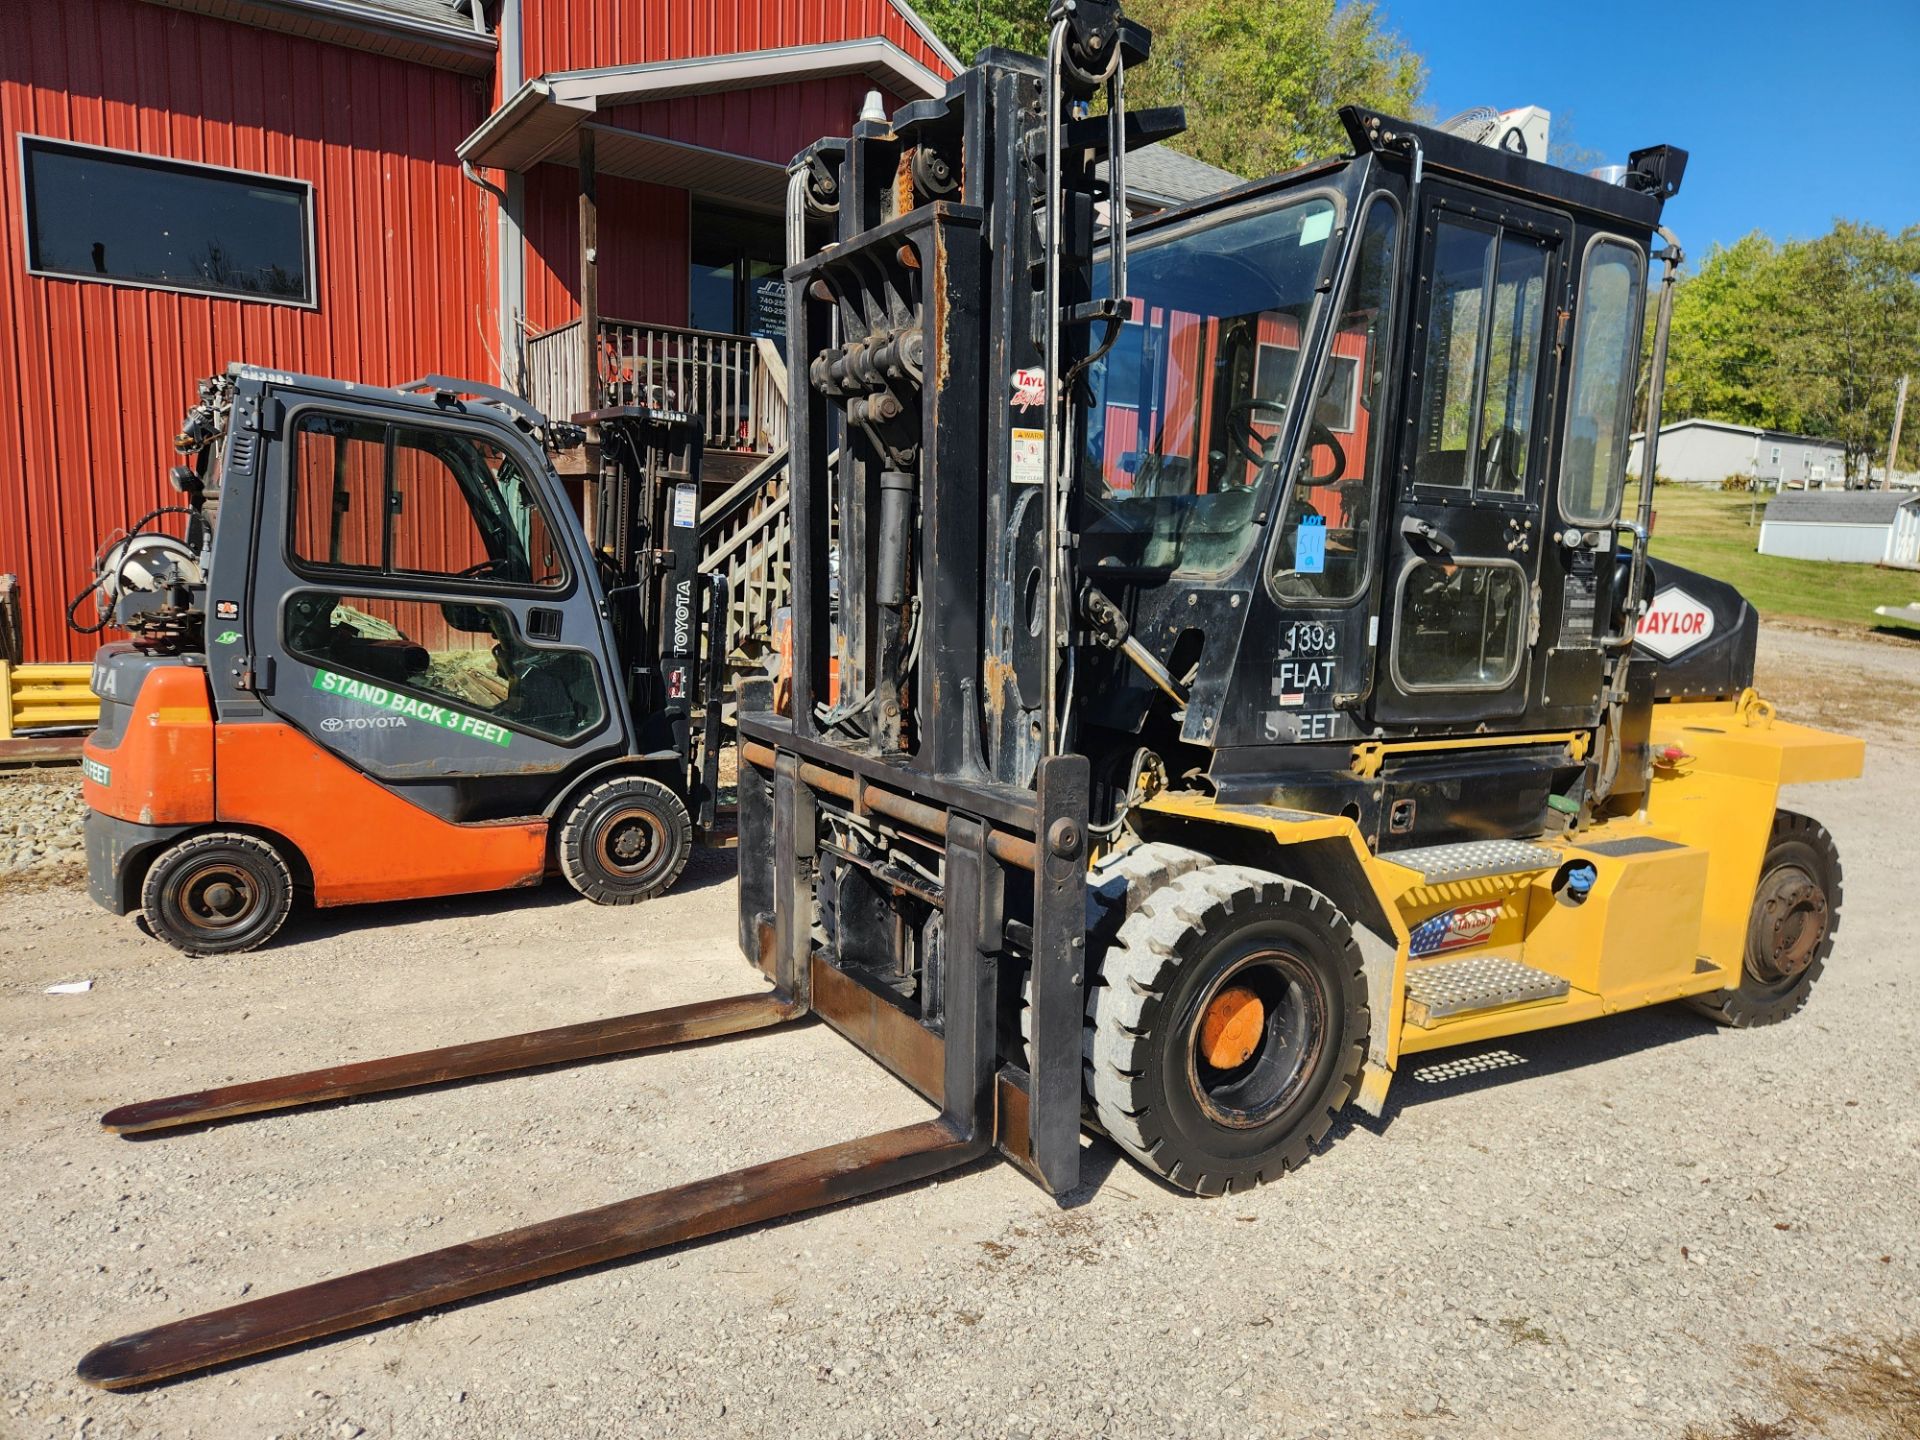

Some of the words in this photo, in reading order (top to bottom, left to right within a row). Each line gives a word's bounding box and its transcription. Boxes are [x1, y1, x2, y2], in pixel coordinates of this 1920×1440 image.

[1018, 371, 1045, 387] TAYL
[1024, 432, 1044, 440] WARN
[674, 580, 691, 658] TOYOTA
[1285, 626, 1336, 652] 1393
[1281, 662, 1336, 688] FLAT
[321, 671, 388, 706] STAND
[391, 693, 442, 724] BACK
[446, 710, 459, 728] 3
[461, 716, 509, 743] FEET
[345, 716, 407, 730] TOYOTA
[1264, 713, 1341, 741] SEET
[89, 760, 110, 785] FEET
